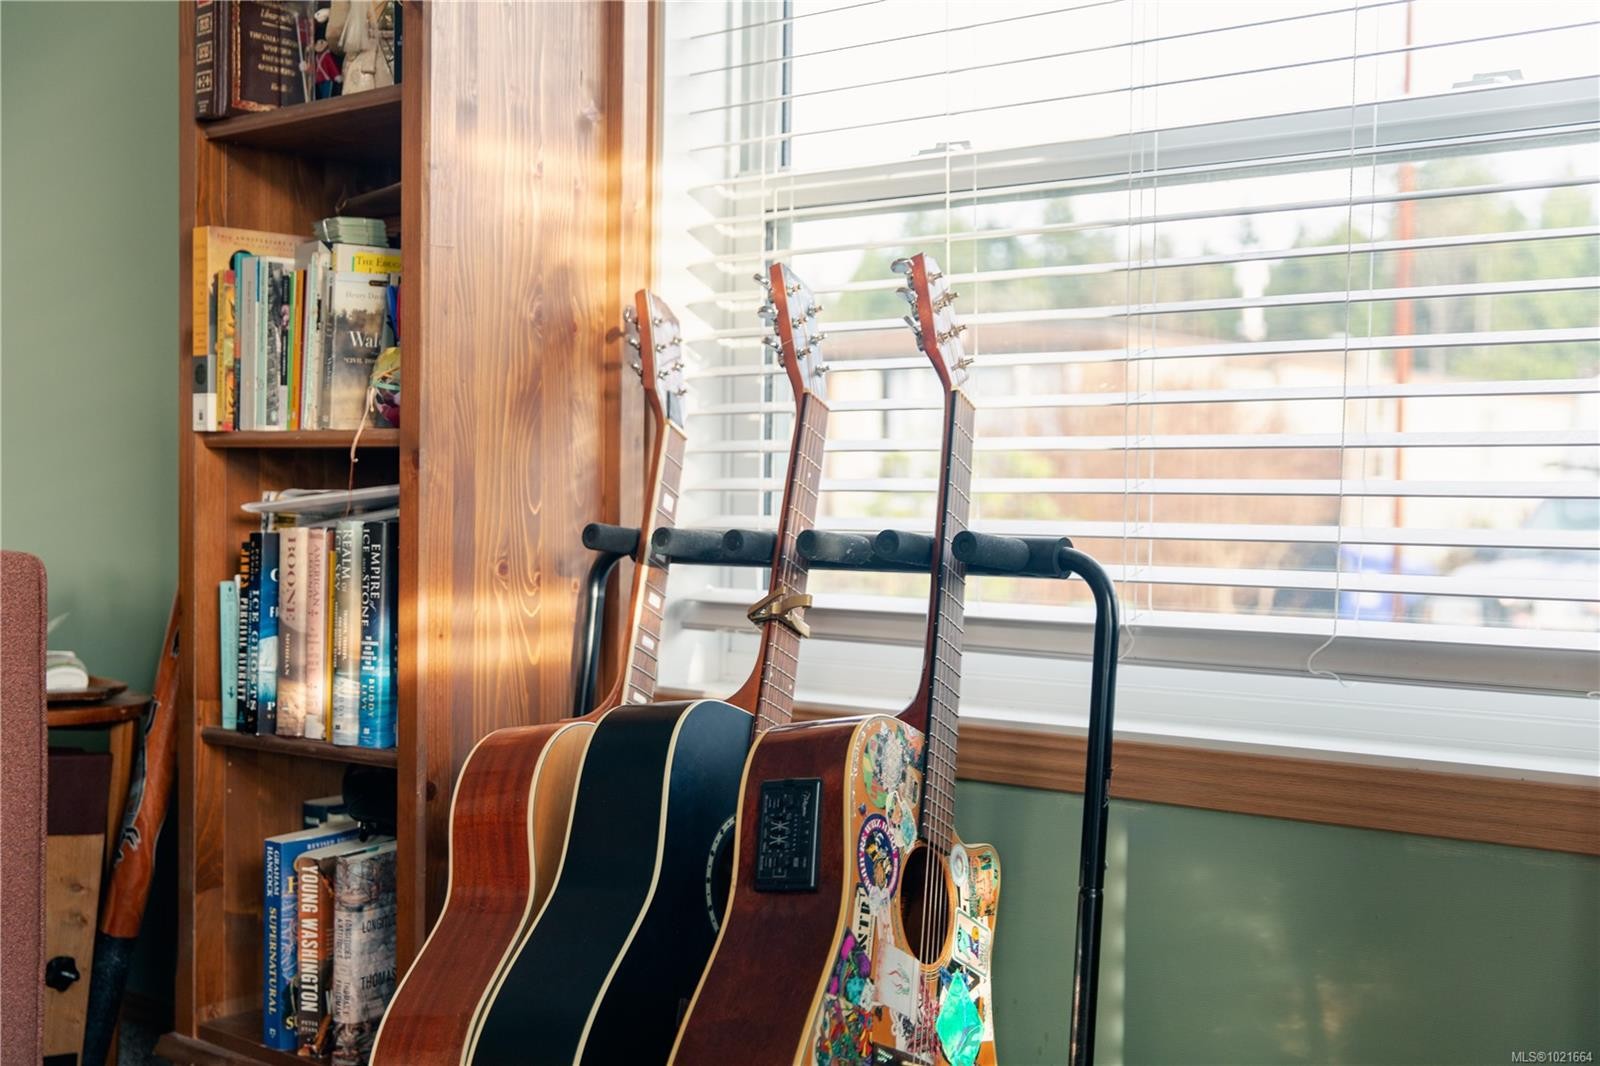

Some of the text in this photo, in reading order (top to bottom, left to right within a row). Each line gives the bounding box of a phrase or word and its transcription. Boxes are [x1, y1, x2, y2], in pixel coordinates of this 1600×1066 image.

[285, 537, 296, 622] BOONE
[312, 543, 321, 607] AMERICAN
[341, 529, 353, 580] REALM
[370, 543, 381, 600] EMPIRE
[252, 590, 260, 622] ICE
[361, 574, 370, 627] STONE
[249, 630, 259, 711] GHOSTS
[367, 678, 375, 718] BUDDY
[266, 846, 274, 897] HANCOCK
[268, 906, 278, 1015] SUPERNATURAL
[301, 865, 319, 1013] YOUNG WASHINGTON
